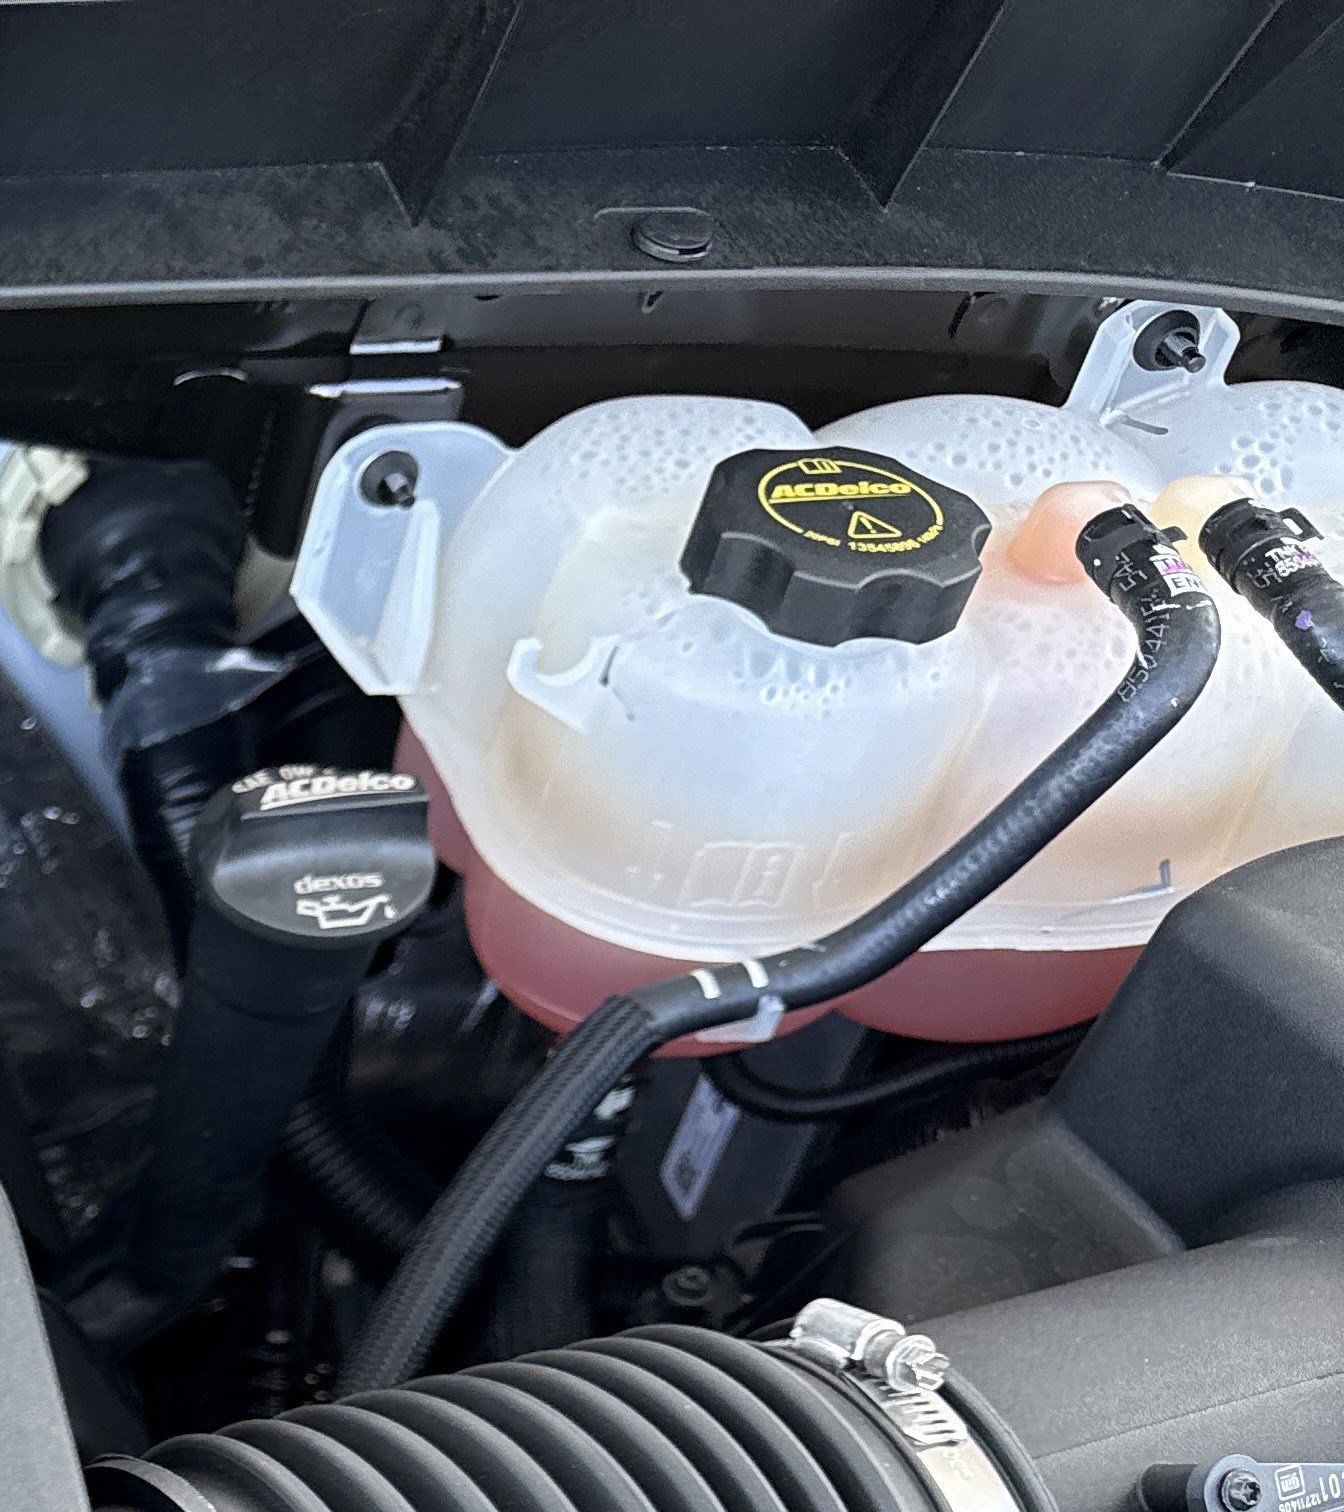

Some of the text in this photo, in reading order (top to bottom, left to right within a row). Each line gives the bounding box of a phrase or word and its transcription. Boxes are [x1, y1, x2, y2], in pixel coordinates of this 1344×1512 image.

[770, 480, 912, 499] ACDelco
[261, 771, 416, 803] ACDelco
[293, 873, 385, 895] dexos
